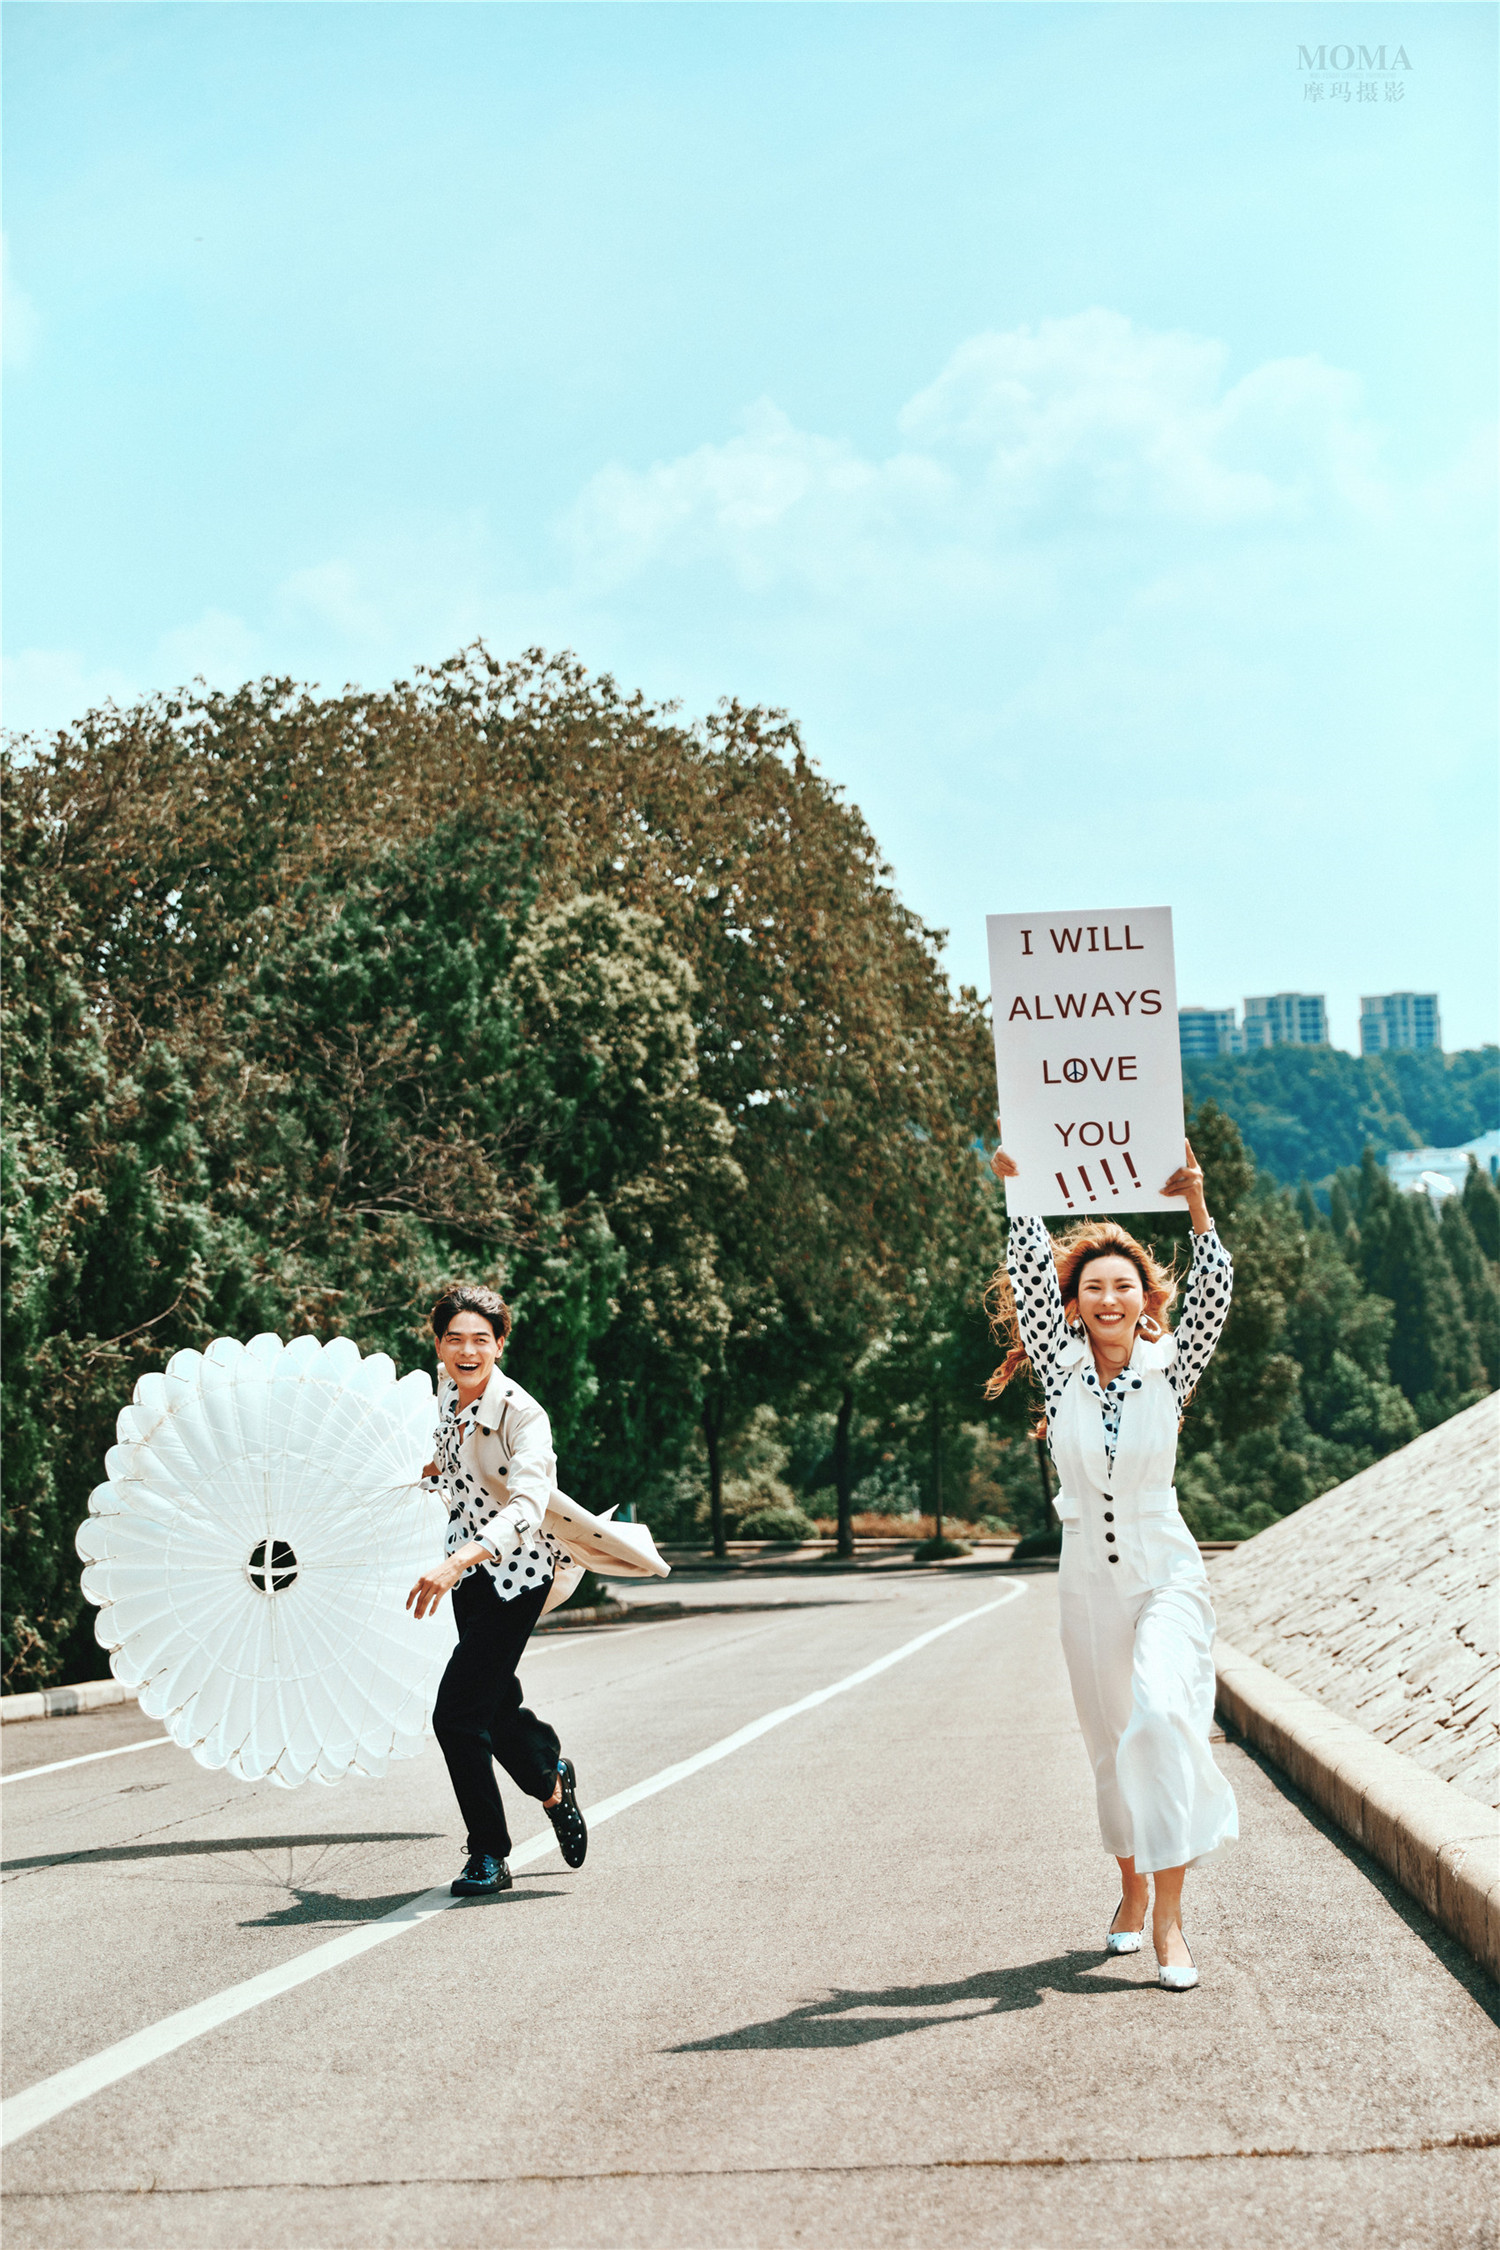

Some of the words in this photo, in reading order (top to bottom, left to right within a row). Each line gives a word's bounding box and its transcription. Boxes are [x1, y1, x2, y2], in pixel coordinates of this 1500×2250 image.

[1021, 930, 1034, 956] I
[1050, 925, 1145, 954] WILL
[1009, 989, 1162, 1022] ALWAYS
[1043, 1056, 1138, 1084] LOVE
[1054, 1121, 1131, 1147] YOU
